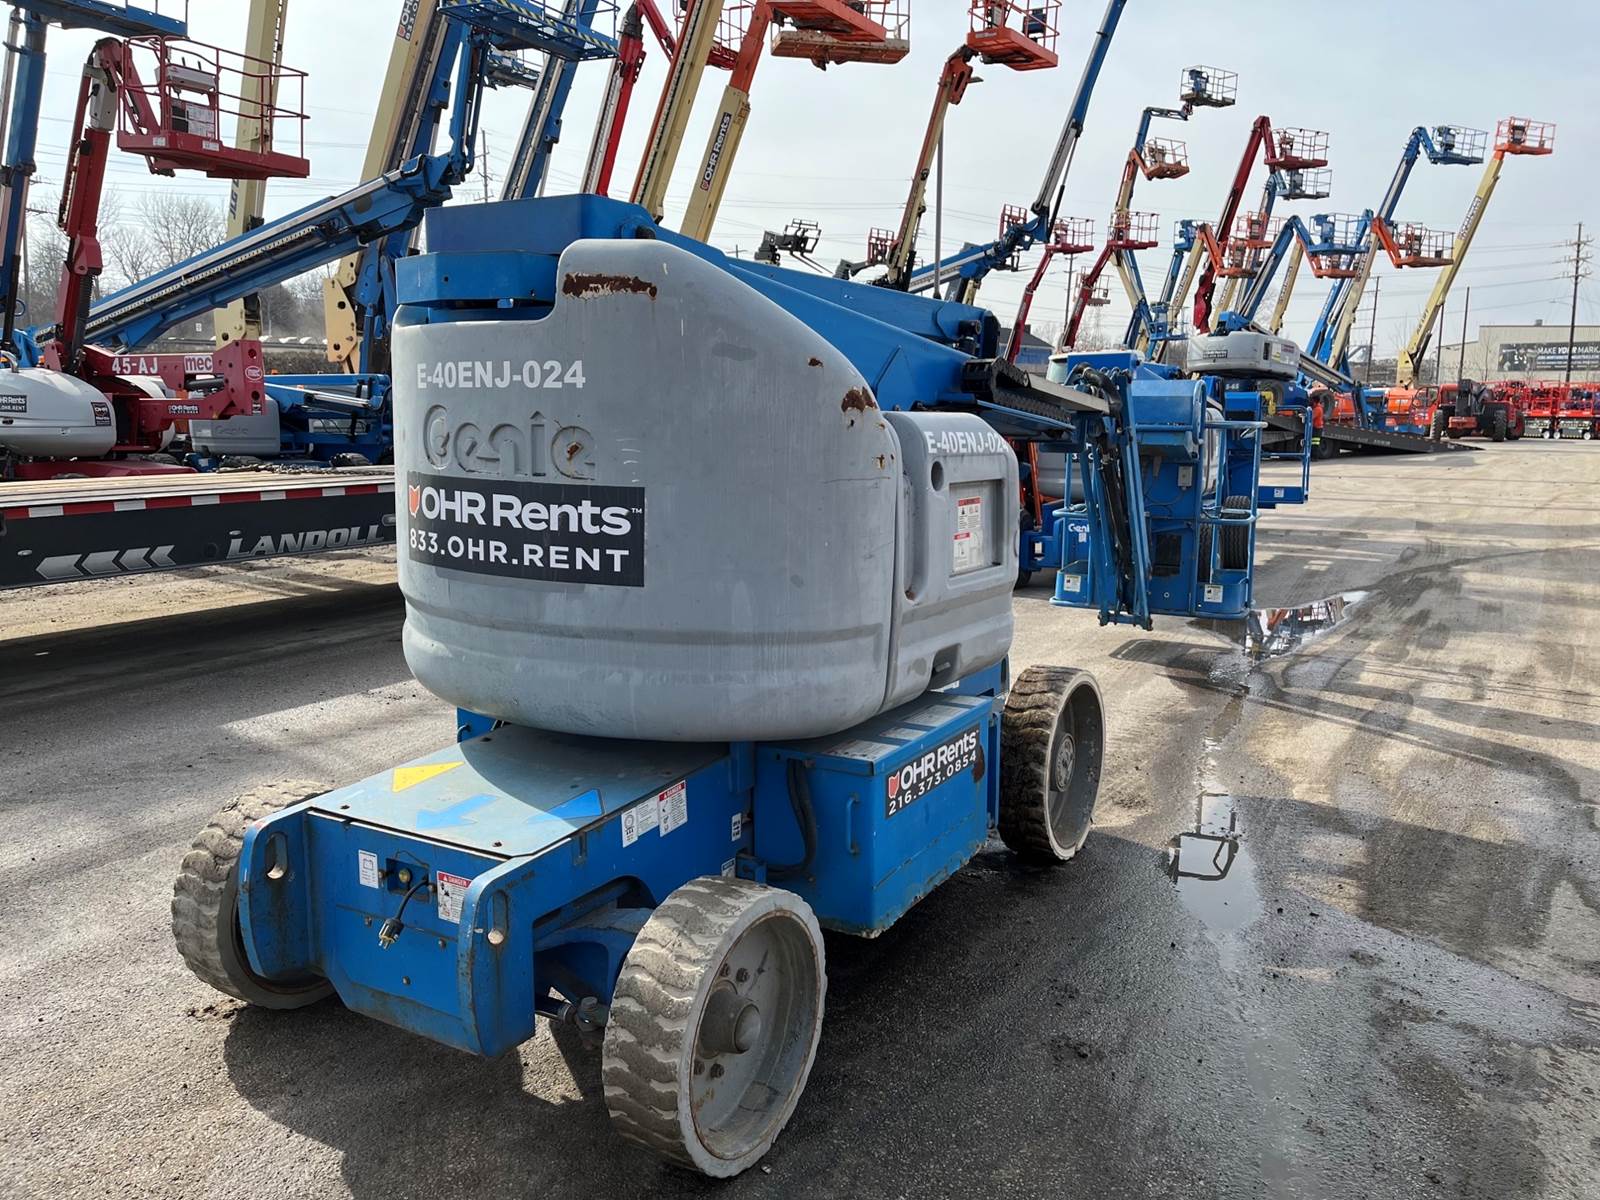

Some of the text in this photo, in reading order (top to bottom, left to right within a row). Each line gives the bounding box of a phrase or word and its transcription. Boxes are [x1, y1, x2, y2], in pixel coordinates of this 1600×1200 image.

[401, 0, 413, 25] OH
[704, 115, 730, 181] OHR Rents
[112, 357, 158, 374] 45-AJ
[185, 356, 213, 371] mec
[1558, 346, 1577, 354] YOR
[417, 360, 586, 389] E-40ENJ-024
[423, 404, 597, 481] Genie
[421, 486, 487, 526] OHR
[492, 493, 632, 536] Rents
[1068, 523, 1090, 533] Geni
[226, 524, 385, 560] LANDOLL
[410, 528, 630, 573] 833.OHR.RENT
[900, 730, 977, 791] OHR Rents
[888, 750, 977, 816] 216.373.0854
